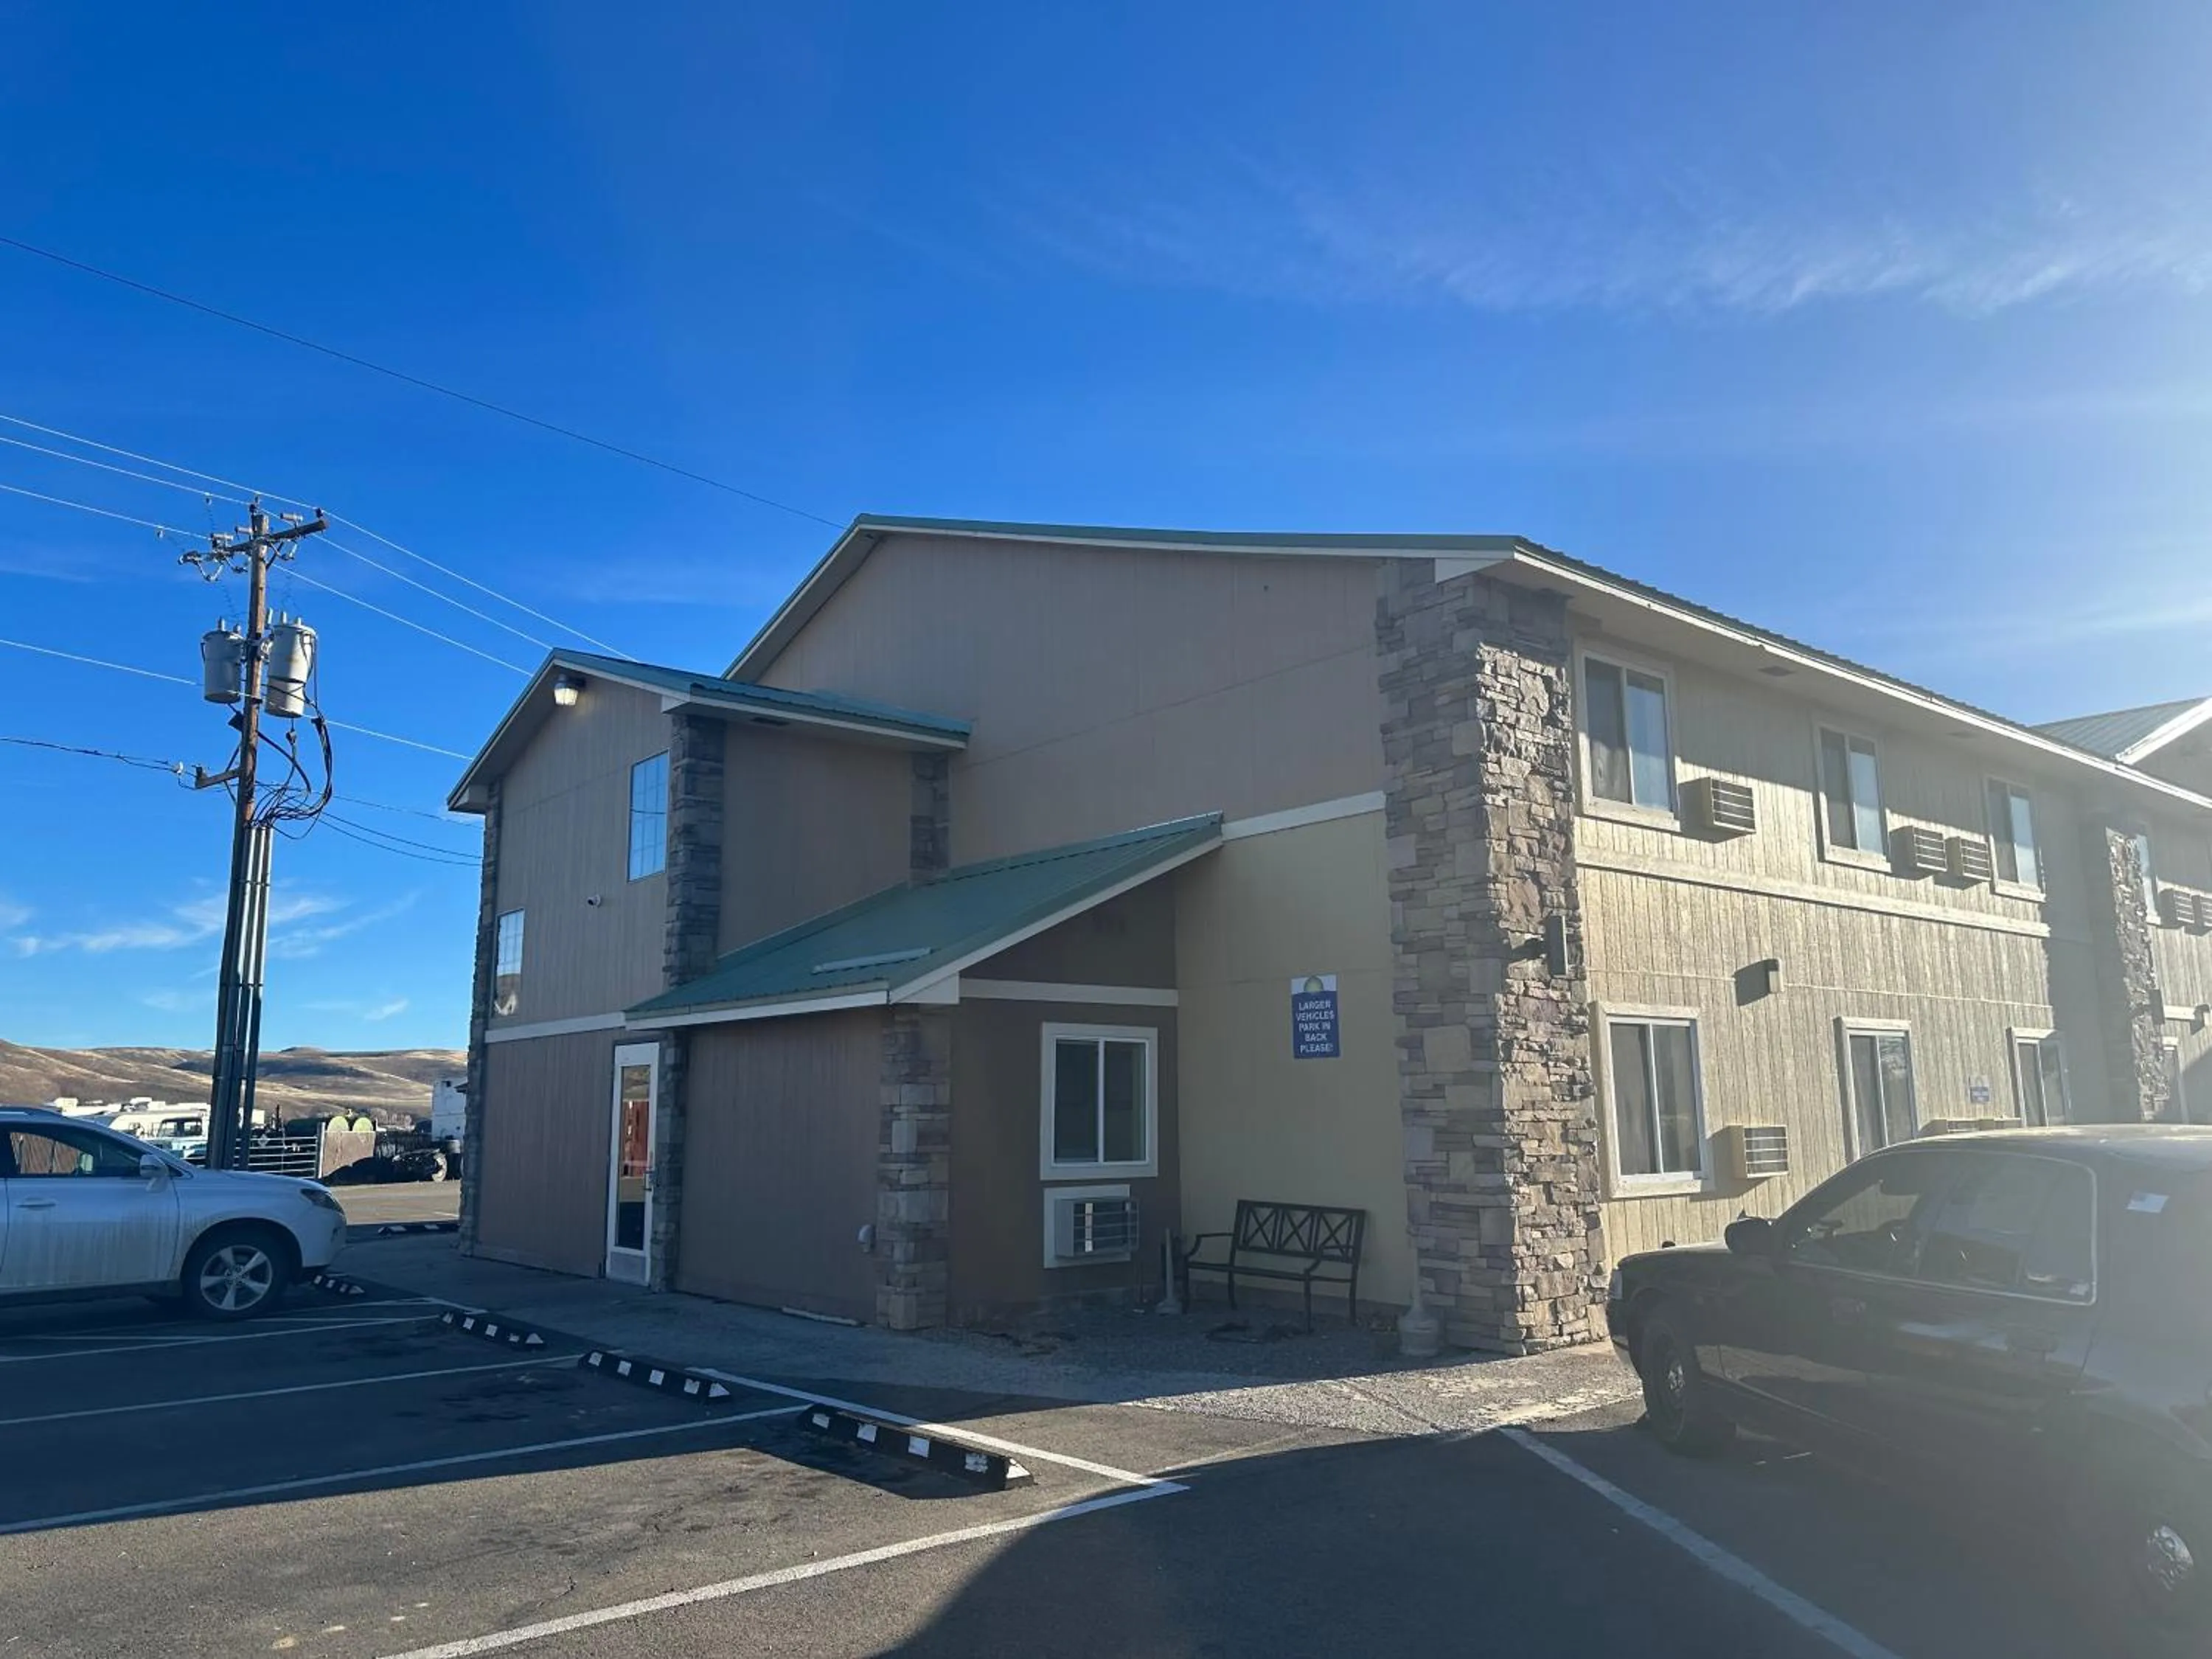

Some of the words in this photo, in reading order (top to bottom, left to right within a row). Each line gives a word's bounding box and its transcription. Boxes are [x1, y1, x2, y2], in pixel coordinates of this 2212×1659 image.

[1298, 1000, 1331, 1011] LARGER
[1295, 1010, 1335, 1021] VEHICLES
[1298, 1022, 1321, 1033] PARK
[1322, 1021, 1331, 1030] IN
[1304, 1032, 1328, 1042] BACK
